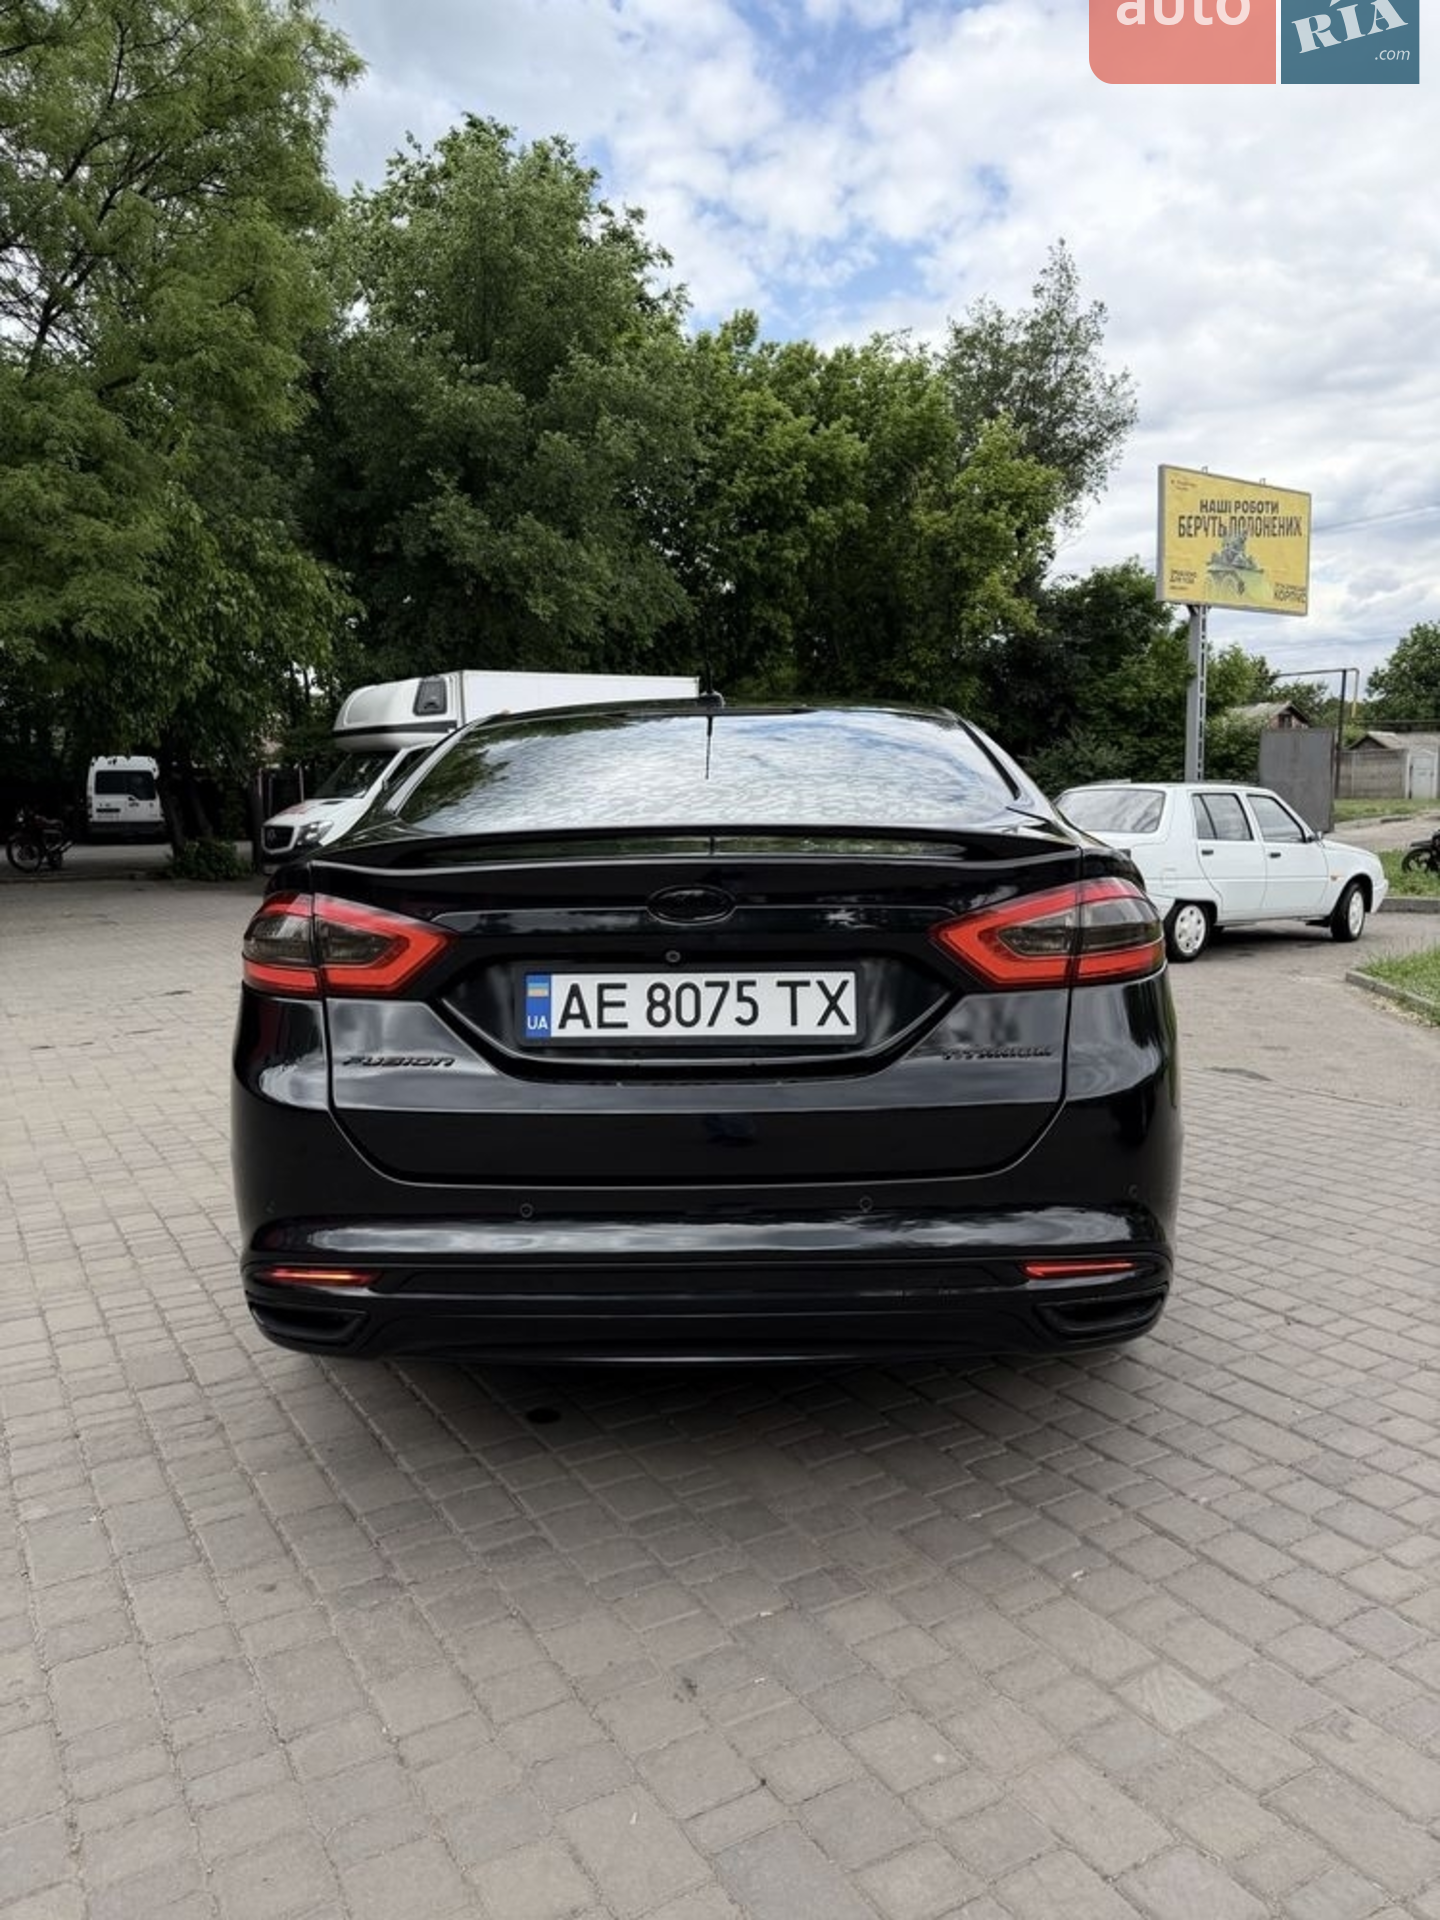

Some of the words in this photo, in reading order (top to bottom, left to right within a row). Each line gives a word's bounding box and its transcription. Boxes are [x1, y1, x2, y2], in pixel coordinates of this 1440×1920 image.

[1199, 499, 1232, 514] НАШІ
[1234, 500, 1280, 514] РОБОТИ
[1178, 515, 1228, 538] БЕРУТЬ
[558, 983, 628, 1029] AE
[646, 981, 759, 1028] 8075
[776, 980, 850, 1026] TX
[527, 1016, 548, 1030] UA
